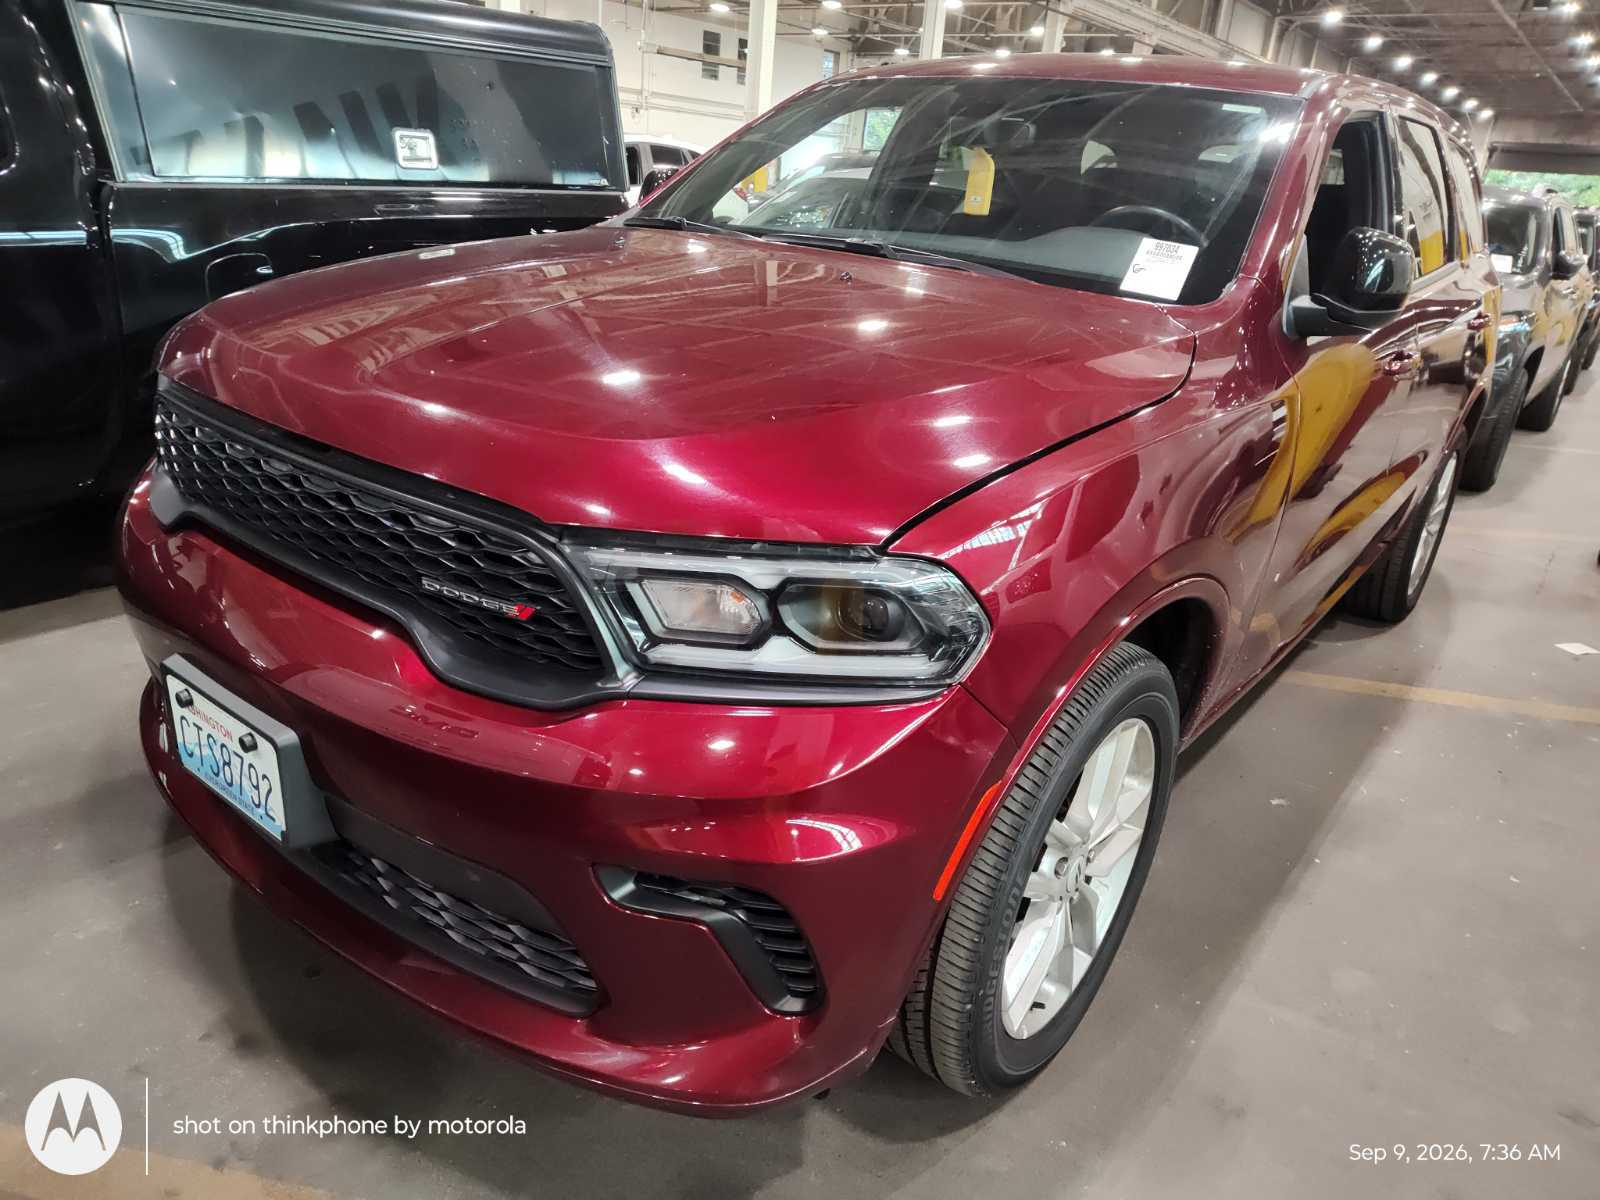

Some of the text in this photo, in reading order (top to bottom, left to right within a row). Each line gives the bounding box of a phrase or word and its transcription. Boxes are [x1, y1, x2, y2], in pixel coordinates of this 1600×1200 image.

[421, 576, 520, 616] DODGE
[187, 704, 233, 742] SHINGTON
[179, 715, 276, 823] CTS8792
